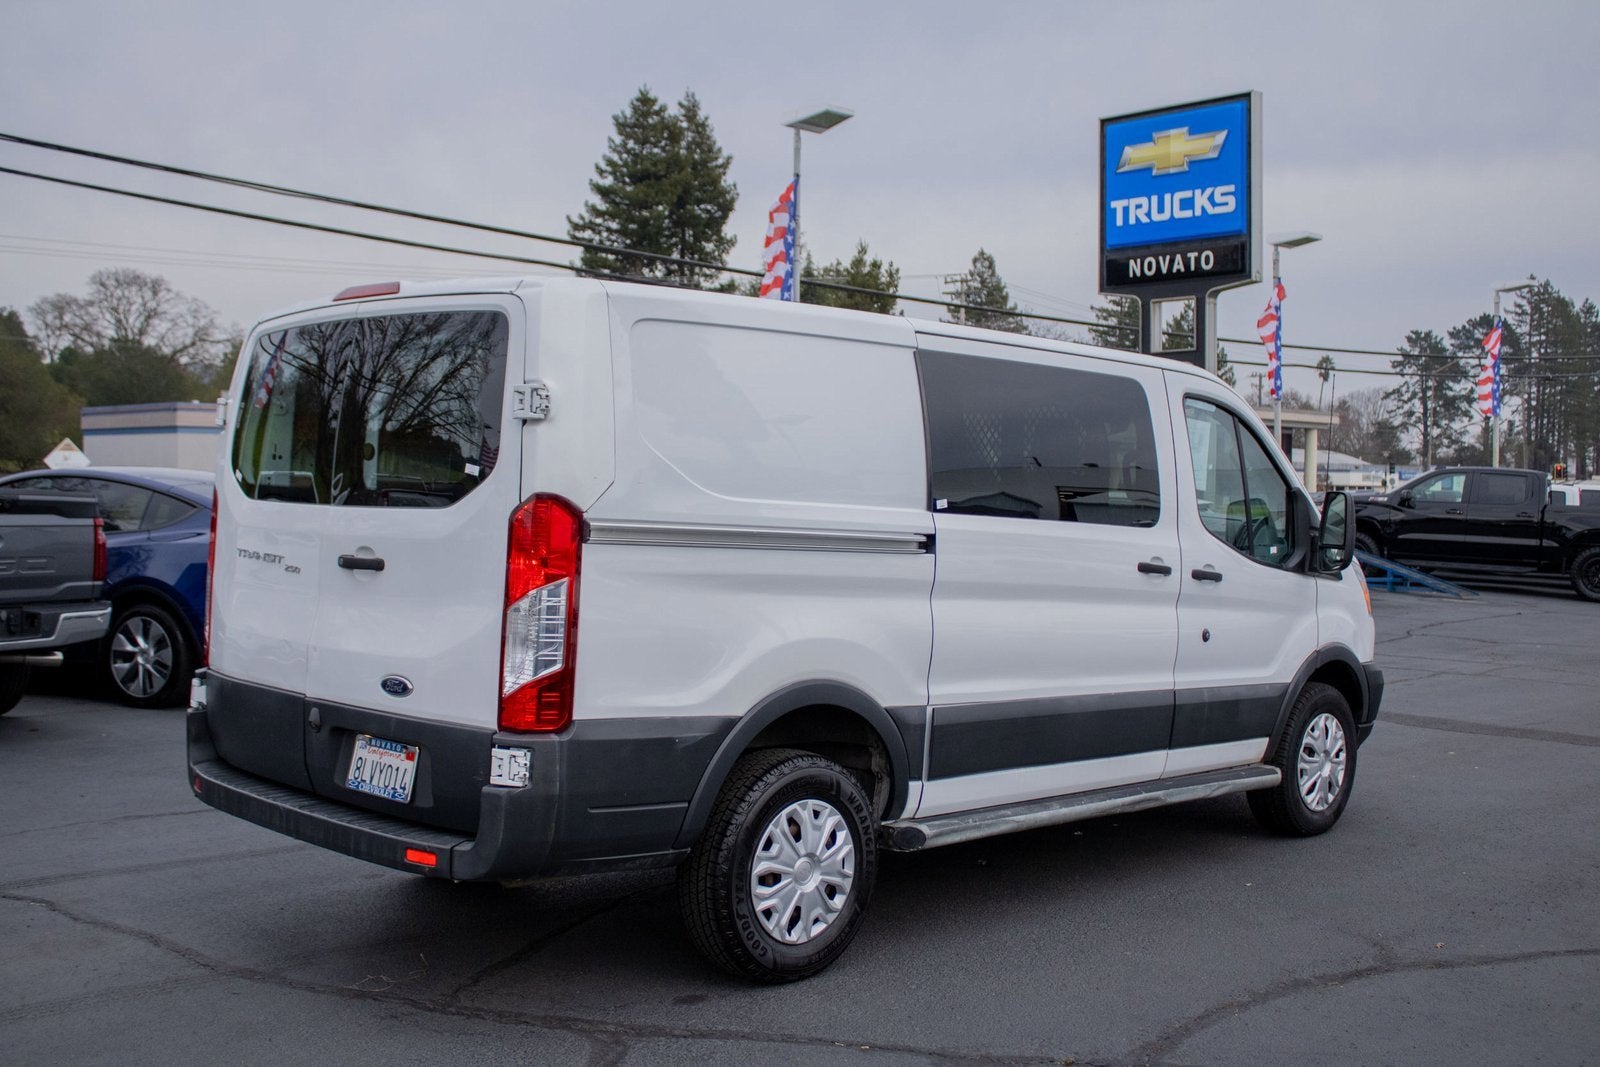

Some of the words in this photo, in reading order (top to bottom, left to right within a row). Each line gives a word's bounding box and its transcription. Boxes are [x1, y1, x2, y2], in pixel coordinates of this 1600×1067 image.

[1110, 184, 1236, 227] TRUCKS
[1128, 250, 1215, 278] NOVATO
[236, 547, 286, 564] TRANSIT
[370, 738, 402, 752] NOVATO
[353, 757, 407, 792] 8LVY014
